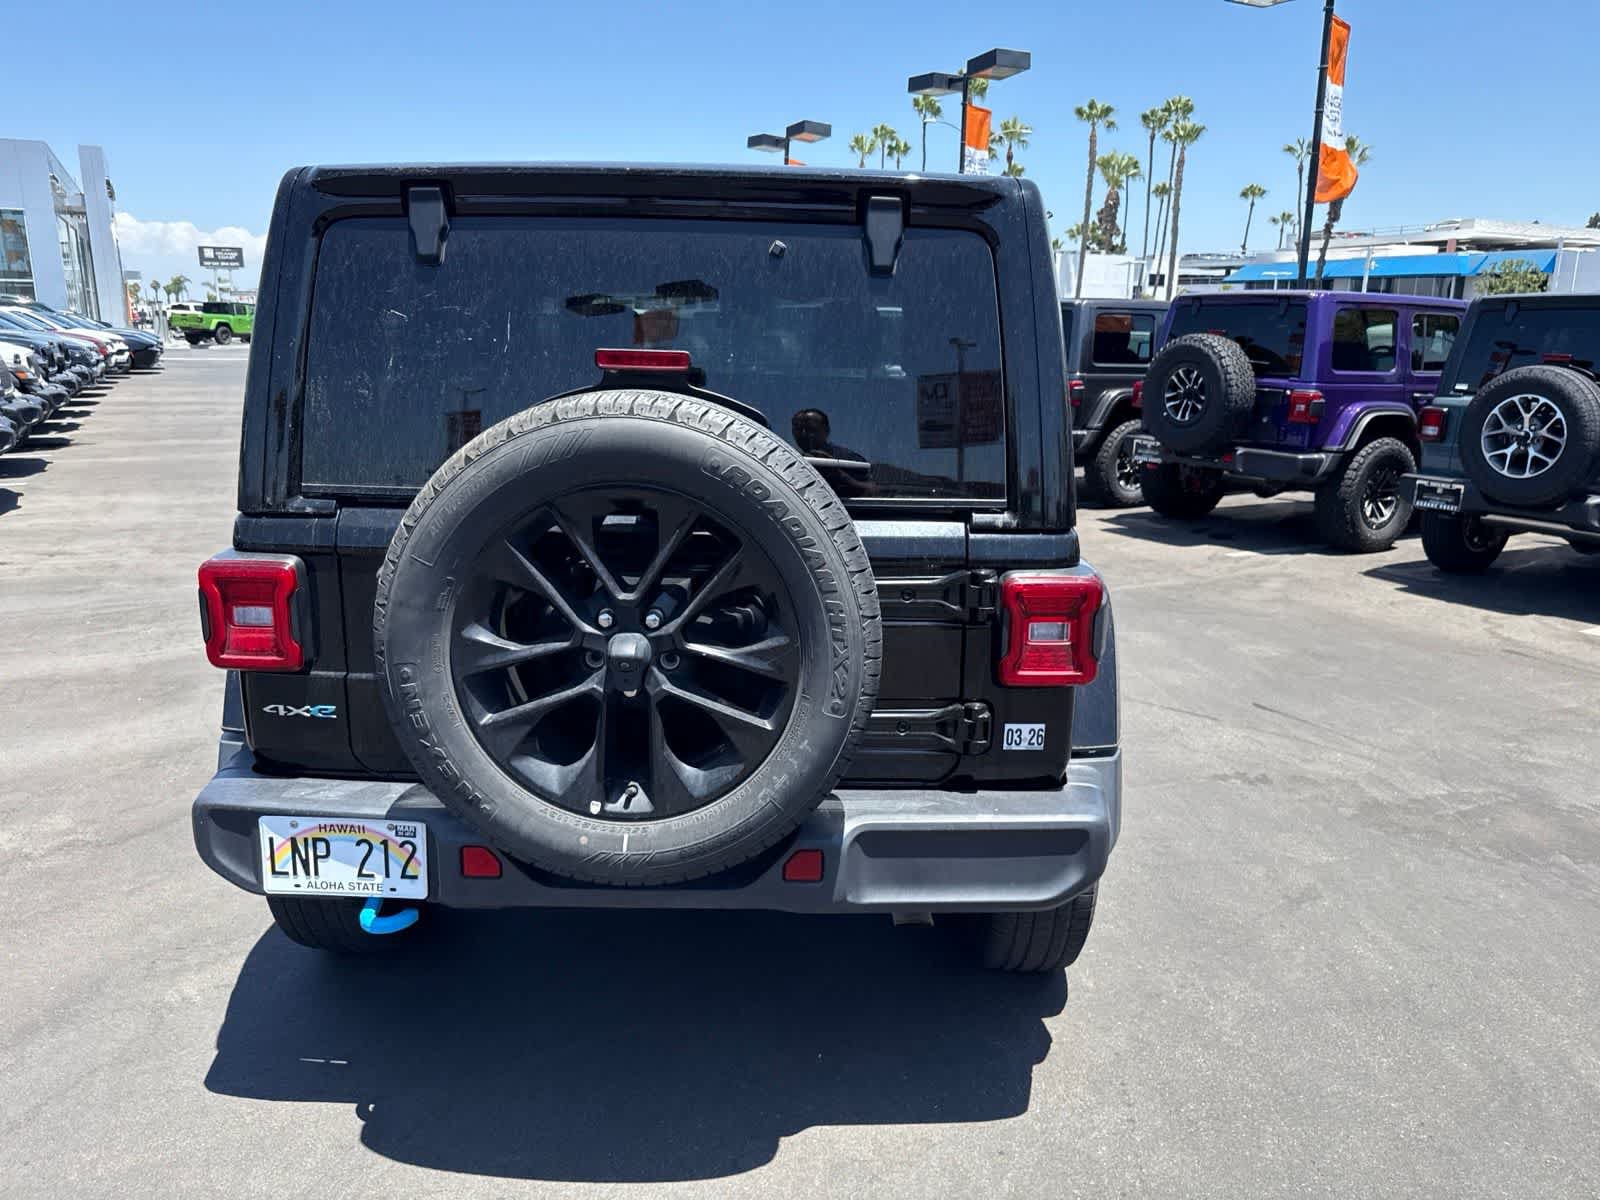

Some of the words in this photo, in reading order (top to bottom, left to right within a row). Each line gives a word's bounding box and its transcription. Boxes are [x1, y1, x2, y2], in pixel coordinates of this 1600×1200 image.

[721, 464, 838, 593] ROADIAN
[1005, 728, 1023, 746] 03
[1028, 728, 1044, 746] 26
[318, 823, 366, 834] HAWAII
[268, 836, 331, 878] LNP
[355, 838, 419, 880] 212
[306, 880, 345, 891] ALOHA
[348, 881, 384, 892] STATE
